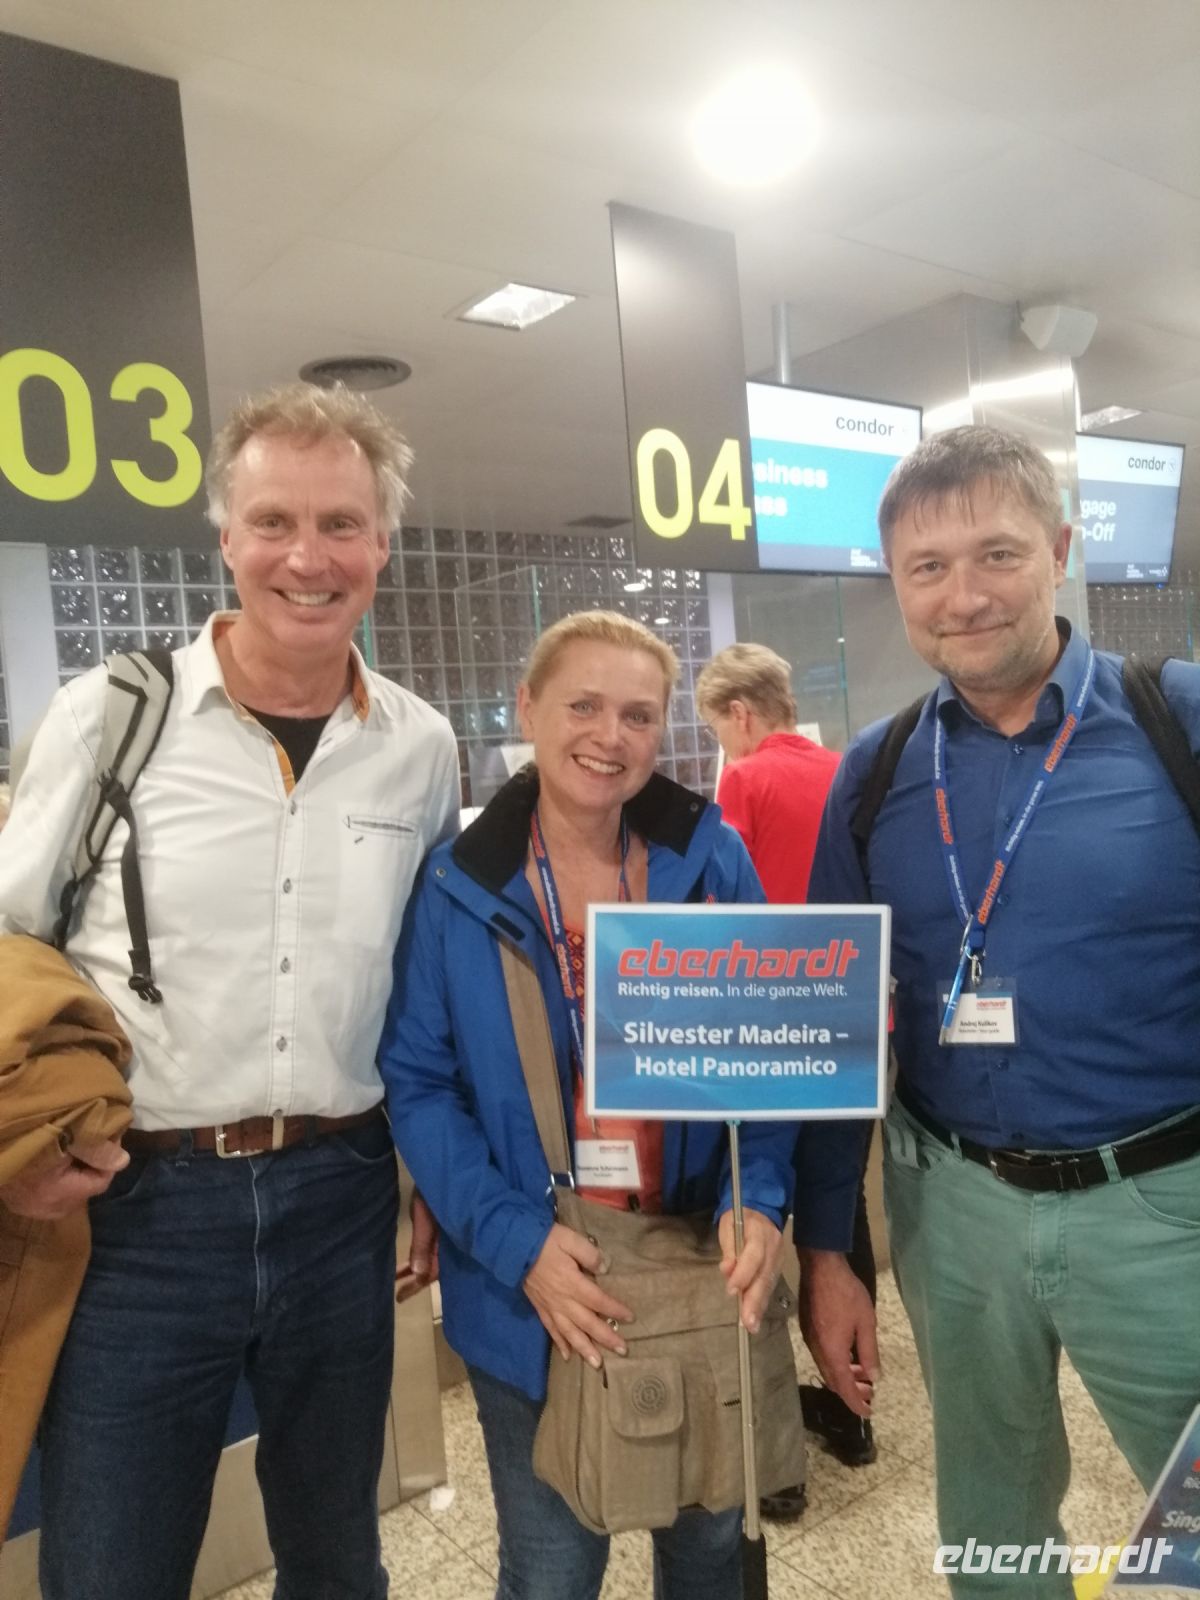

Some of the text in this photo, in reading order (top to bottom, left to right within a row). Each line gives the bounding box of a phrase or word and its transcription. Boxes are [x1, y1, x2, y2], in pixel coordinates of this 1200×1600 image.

[0, 348, 202, 507] 03
[835, 416, 894, 437] condor
[1128, 456, 1166, 471] condor
[636, 428, 752, 541] 04
[618, 939, 860, 978] eberhardt
[618, 982, 848, 1000] Richtig reisen. In die ganze Welt.
[624, 1021, 733, 1045] Silvester
[738, 1024, 831, 1045] Madeira
[635, 1056, 837, 1077] Hotel Panoramico
